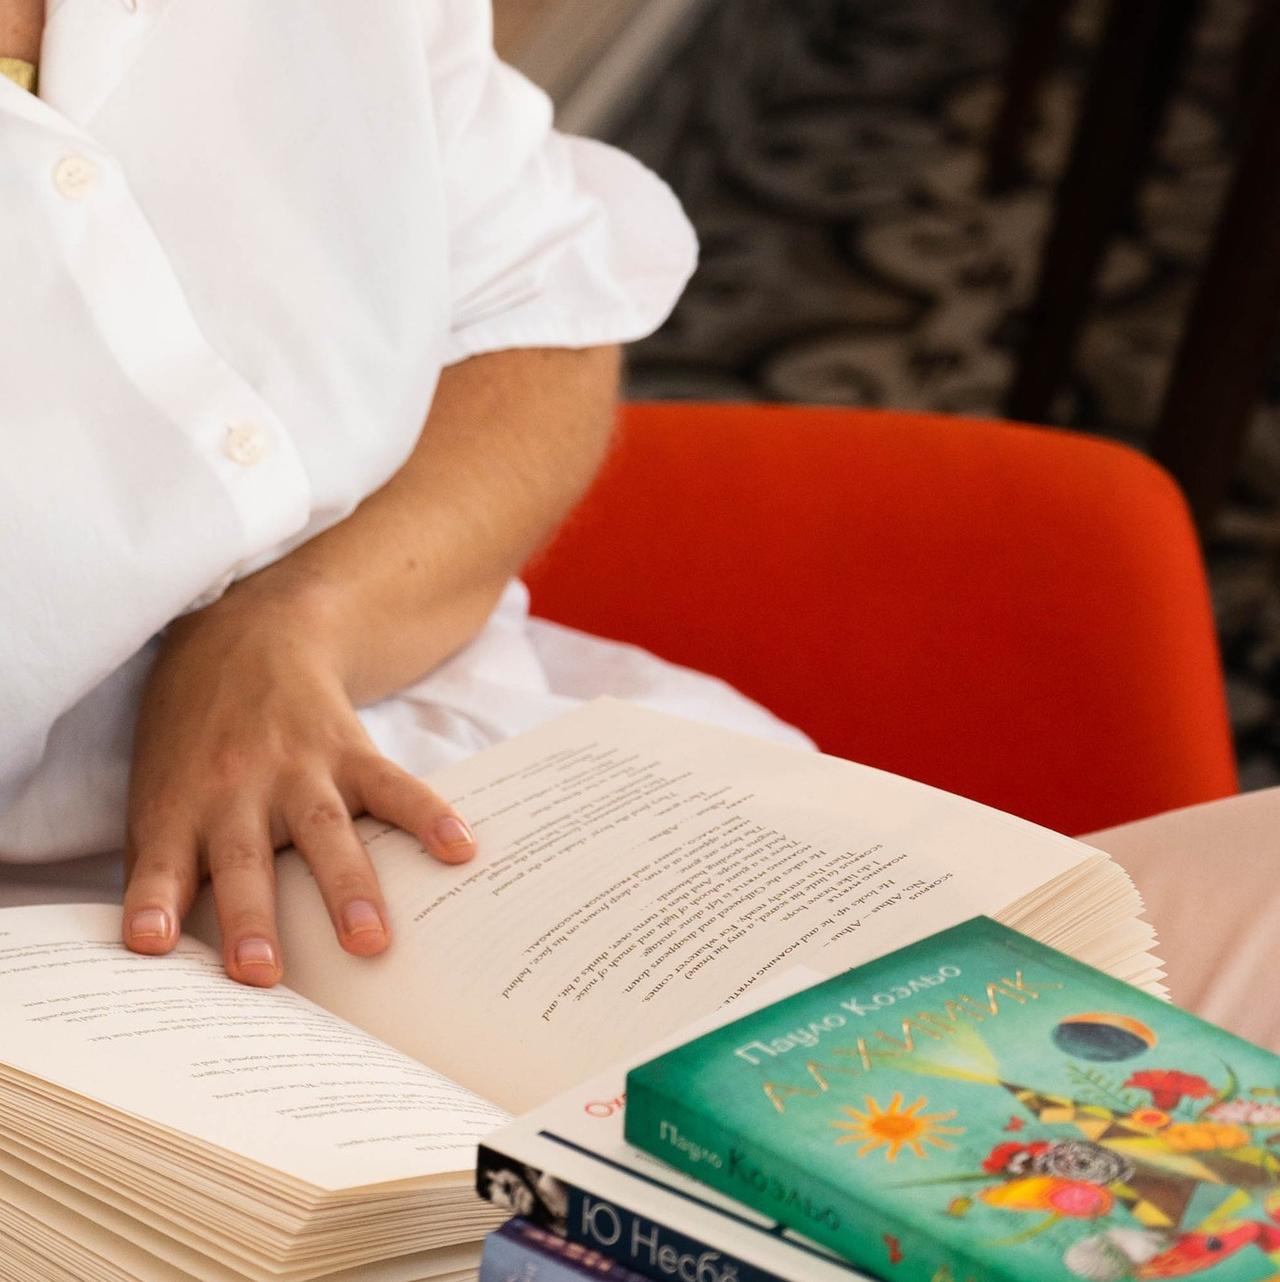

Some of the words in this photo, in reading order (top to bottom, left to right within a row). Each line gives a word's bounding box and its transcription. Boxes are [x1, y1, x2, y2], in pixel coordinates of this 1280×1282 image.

[742, 825, 765, 837] The
[745, 829, 779, 847] begins
[763, 833, 787, 849] And
[682, 835, 719, 858] appears
[718, 835, 745, 850] boys
[769, 839, 800, 857] There
[703, 846, 745, 871] spooling
[740, 847, 764, 861] time
[823, 850, 857, 868] Then
[630, 864, 652, 878] and
[675, 857, 702, 874] gone.
[724, 865, 750, 883] giant
[781, 859, 808, 876] takes
[655, 869, 708, 902] backwards
[689, 877, 712, 893] And
[803, 876, 829, 891] little
[835, 873, 859, 886] like
[901, 878, 926, 892] No,
[581, 876, 632, 909] PROFESSOR
[608, 887, 632, 904] deep
[666, 891, 690, 907] then
[688, 882, 725, 906] whoosh
[766, 877, 806, 903] entirely
[806, 885, 838, 905] brave
[849, 889, 879, 906] looks
[412, 886, 462, 922] Hogwarts
[704, 898, 724, 910] left
[715, 885, 766, 918] Gillyweed
[753, 899, 789, 923] scared,
[870, 892, 902, 913] Albus
[578, 902, 610, 924] frown
[631, 912, 659, 932] turns
[655, 912, 680, 929] light
[677, 909, 704, 929] alone
[736, 902, 767, 923] ready.
[779, 904, 810, 922] boys.
[696, 916, 718, 932] and
[718, 923, 739, 937] For
[829, 919, 861, 941] Albus
[551, 934, 568, 947] his
[607, 931, 632, 949] over,
[635, 927, 656, 945] and
[639, 928, 677, 957] onstage.
[726, 928, 747, 944] tiny
[799, 927, 820, 942] and
[528, 945, 553, 965] face,
[607, 943, 637, 968] smash
[649, 930, 697, 968] disappears
[673, 937, 719, 974] whatever
[755, 941, 801, 976] MOANING
[580, 951, 609, 975] thinks
[596, 967, 610, 979] of
[683, 953, 716, 980] brave)
[500, 967, 532, 999] behind
[556, 983, 576, 998] bit,
[572, 978, 598, 1002] noise.
[621, 968, 650, 994] down.
[641, 973, 674, 1002] comes.
[722, 975, 757, 1004] MYRTLE
[540, 999, 560, 1021] and
[734, 1015, 846, 1066] Пауло
[840, 964, 961, 1017] Коэльо
[763, 970, 1064, 1114] АЛХИМИК
[660, 1119, 722, 1168] Пауло
[728, 1147, 841, 1231] Коэльо
[581, 1195, 621, 1247] Ю
